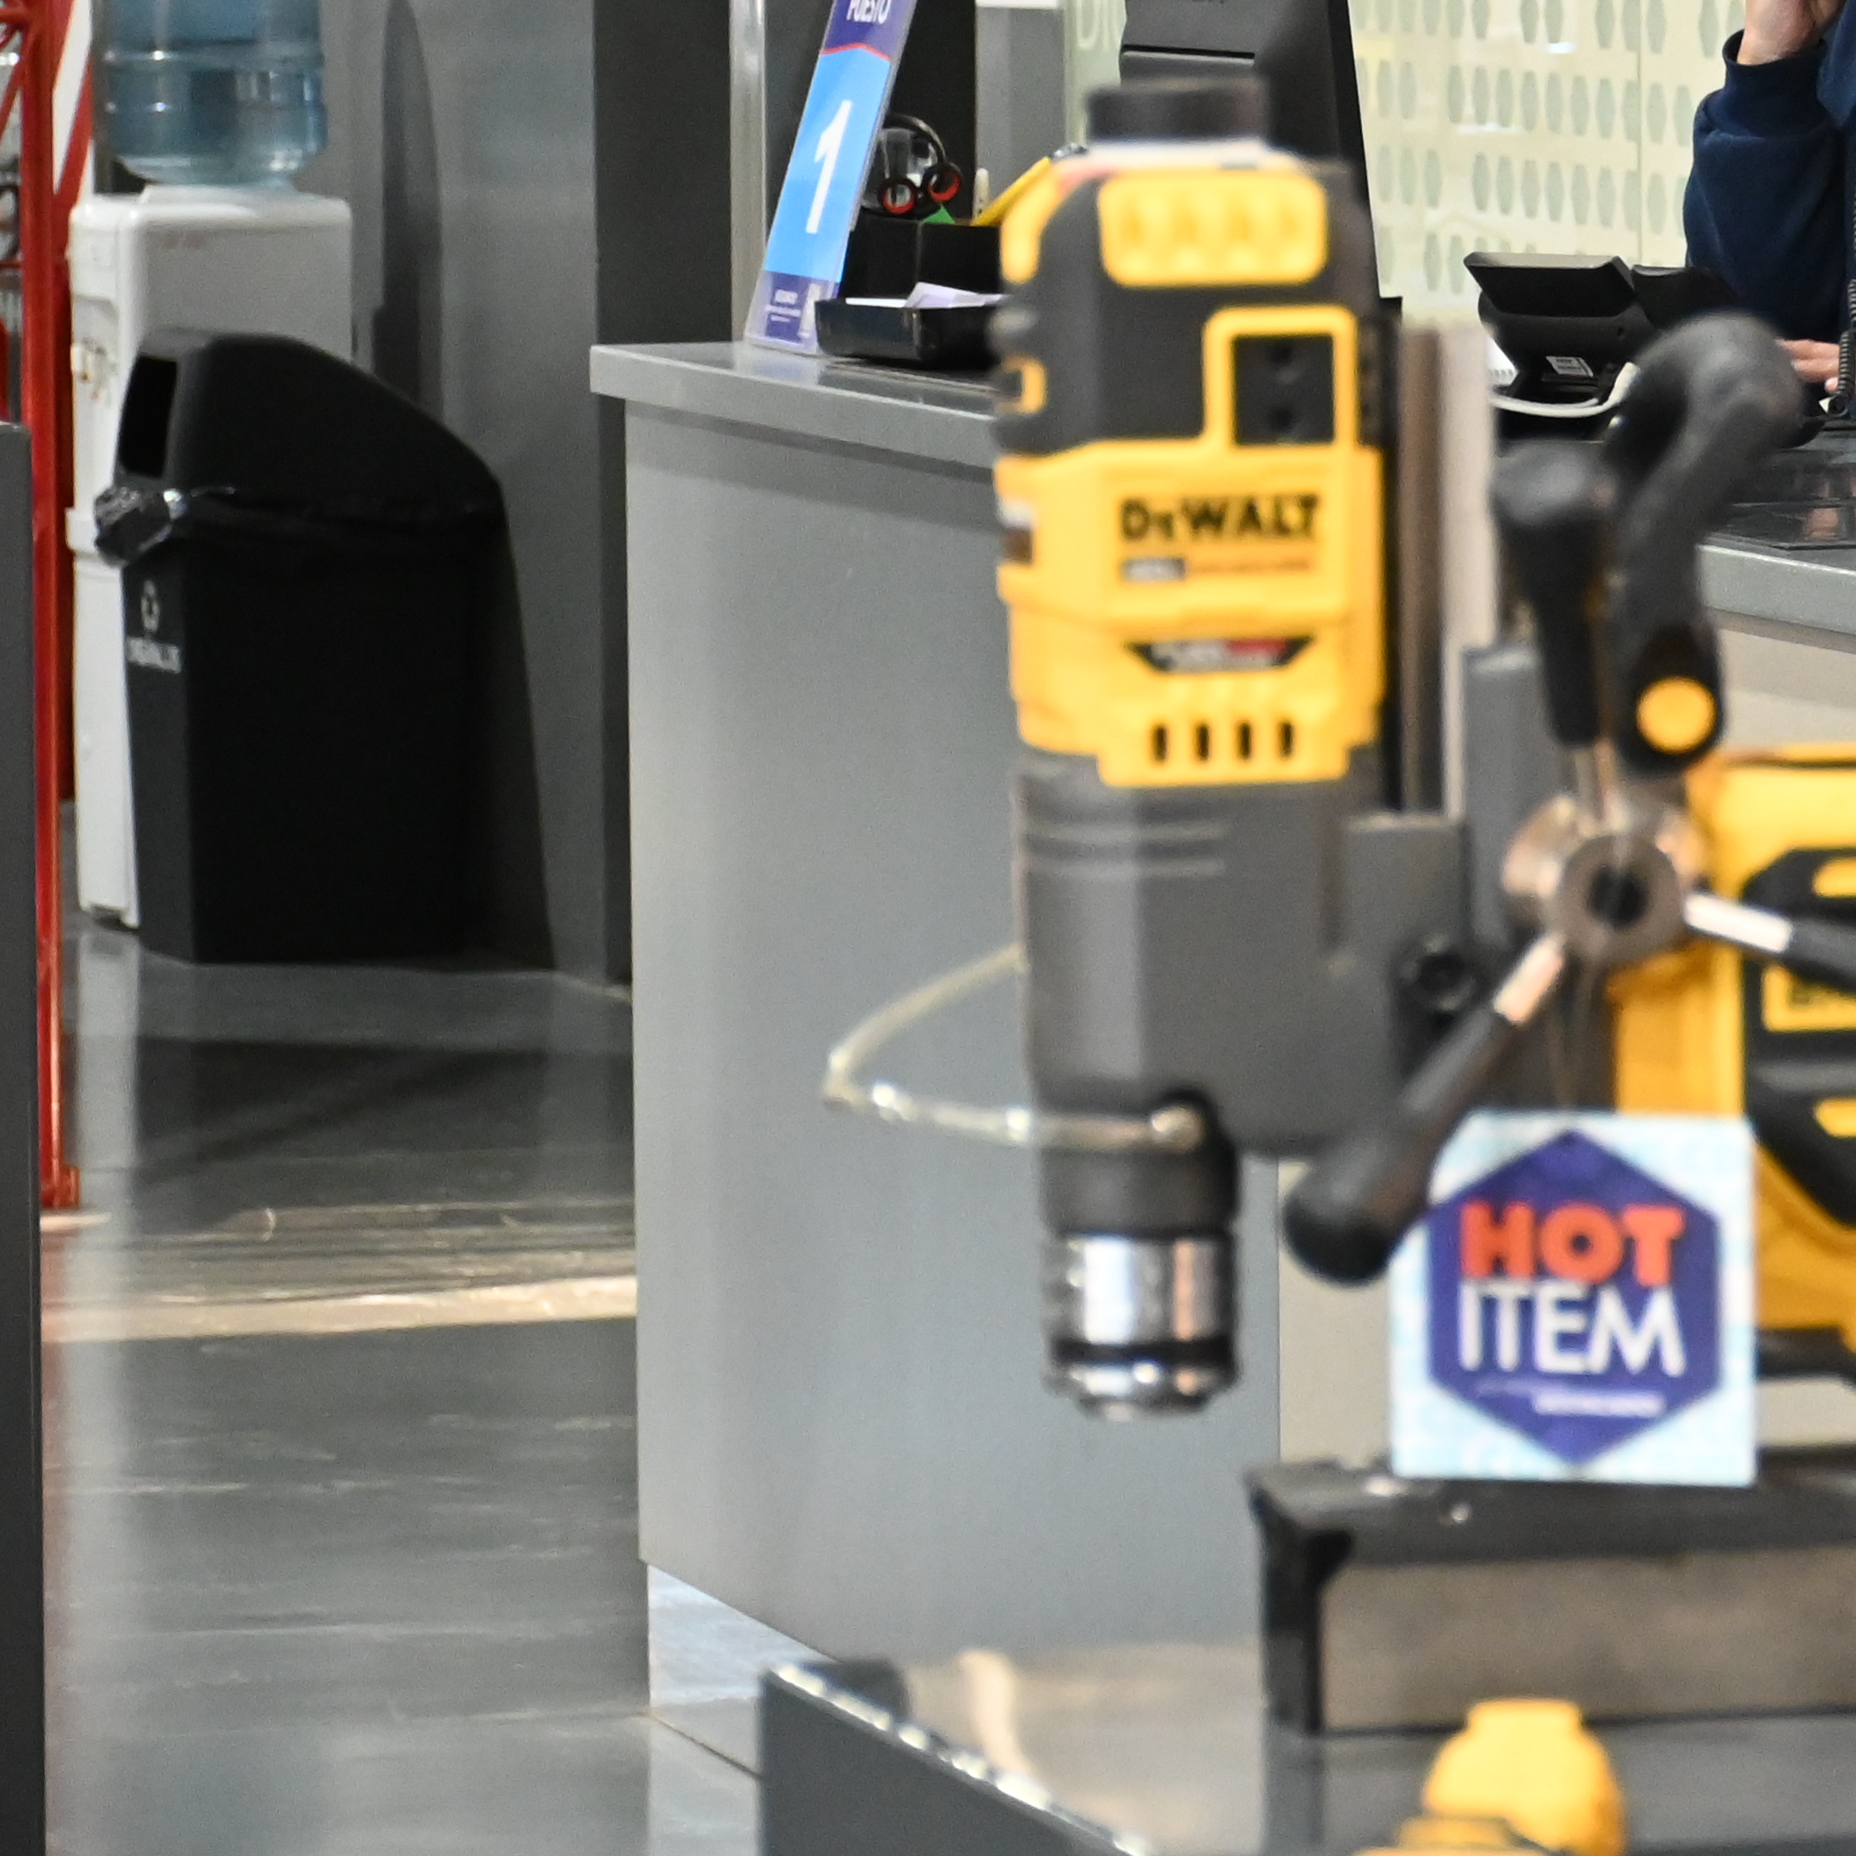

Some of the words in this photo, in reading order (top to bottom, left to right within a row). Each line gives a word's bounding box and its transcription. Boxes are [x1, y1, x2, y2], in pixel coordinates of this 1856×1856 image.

[805, 100, 853, 235] 1
[1460, 1200, 1686, 1290] HOT
[1459, 1280, 1687, 1378] ITEM
